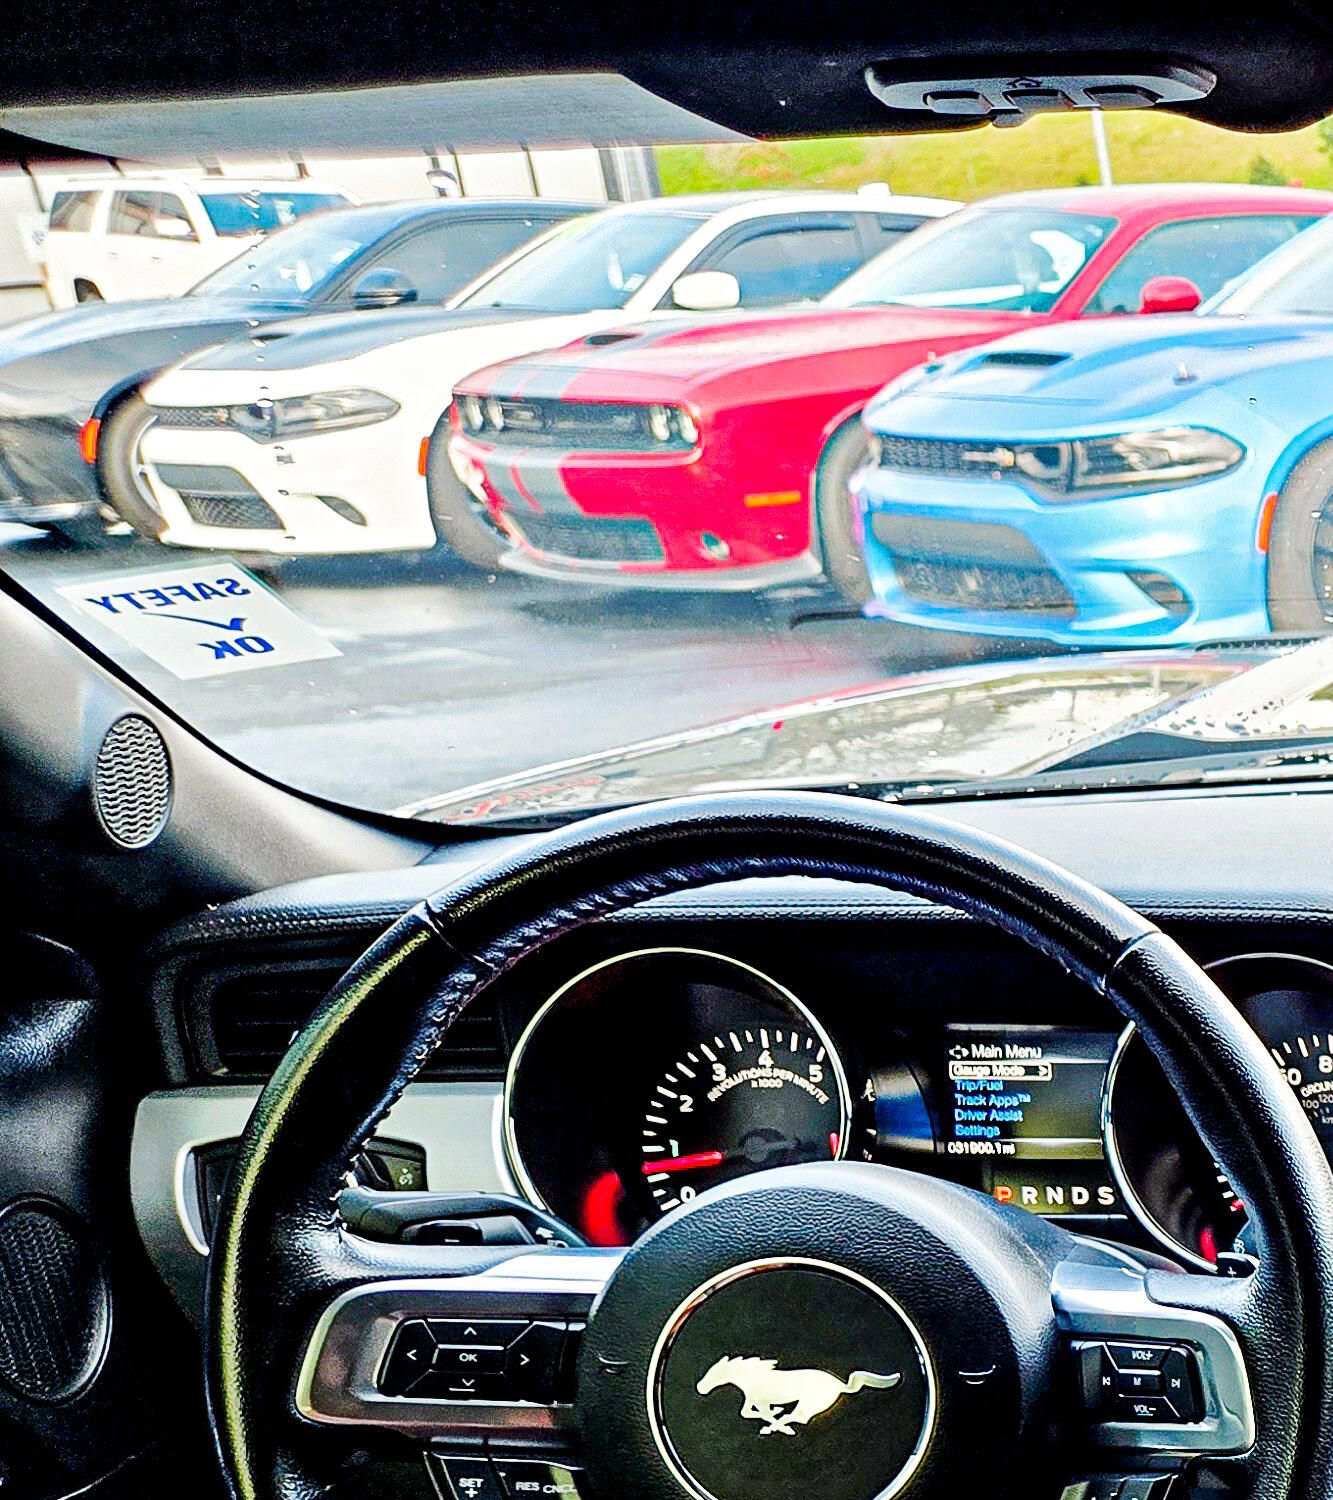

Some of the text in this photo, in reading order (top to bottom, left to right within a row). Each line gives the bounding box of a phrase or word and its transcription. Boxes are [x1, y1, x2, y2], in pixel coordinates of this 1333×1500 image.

[758, 1050, 774, 1067] 4
[971, 1044, 1042, 1059] Main Menu
[712, 1063, 726, 1081] 3
[809, 1065, 823, 1082] 5
[953, 1064, 1025, 1078] Gauge Mode
[955, 1080, 1003, 1092] Trip/Fuel
[679, 1095, 693, 1112] 2
[955, 1093, 986, 1106] Track
[955, 1109, 1024, 1121] Driver Assist
[955, 1124, 1000, 1138] Settings
[669, 1139, 678, 1157] 1
[680, 1186, 696, 1203] 0
[1022, 1186, 1038, 1204] R
[1046, 1186, 1064, 1204] N
[1072, 1186, 1089, 1204] D
[1098, 1186, 1115, 1204] S
[459, 1353, 477, 1363] OK
[459, 1478, 483, 1488] SET
[515, 1481, 539, 1492] RES
